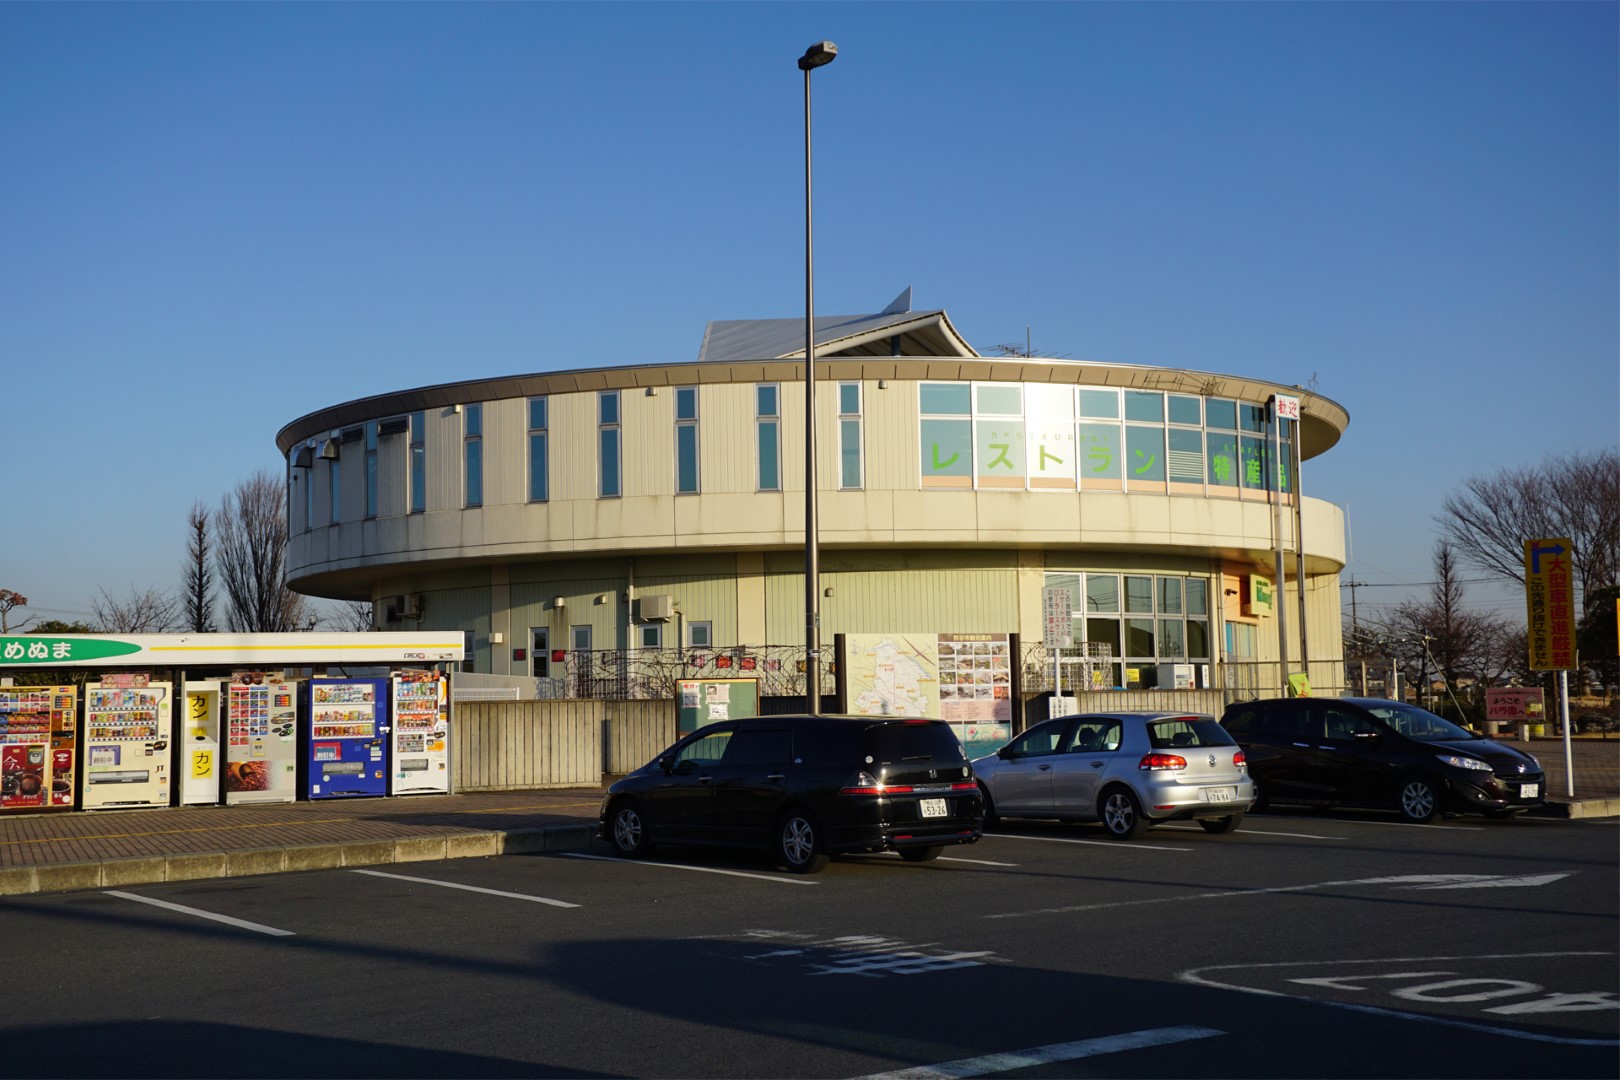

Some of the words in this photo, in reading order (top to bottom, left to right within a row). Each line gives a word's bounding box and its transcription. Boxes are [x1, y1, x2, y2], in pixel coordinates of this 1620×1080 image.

[931, 443, 1156, 475] レストラン
[1547, 557, 1572, 667] 大型車直進厳禁
[191, 695, 208, 719] カン
[195, 752, 211, 776] カン
[926, 805, 946, 816] 53-26
